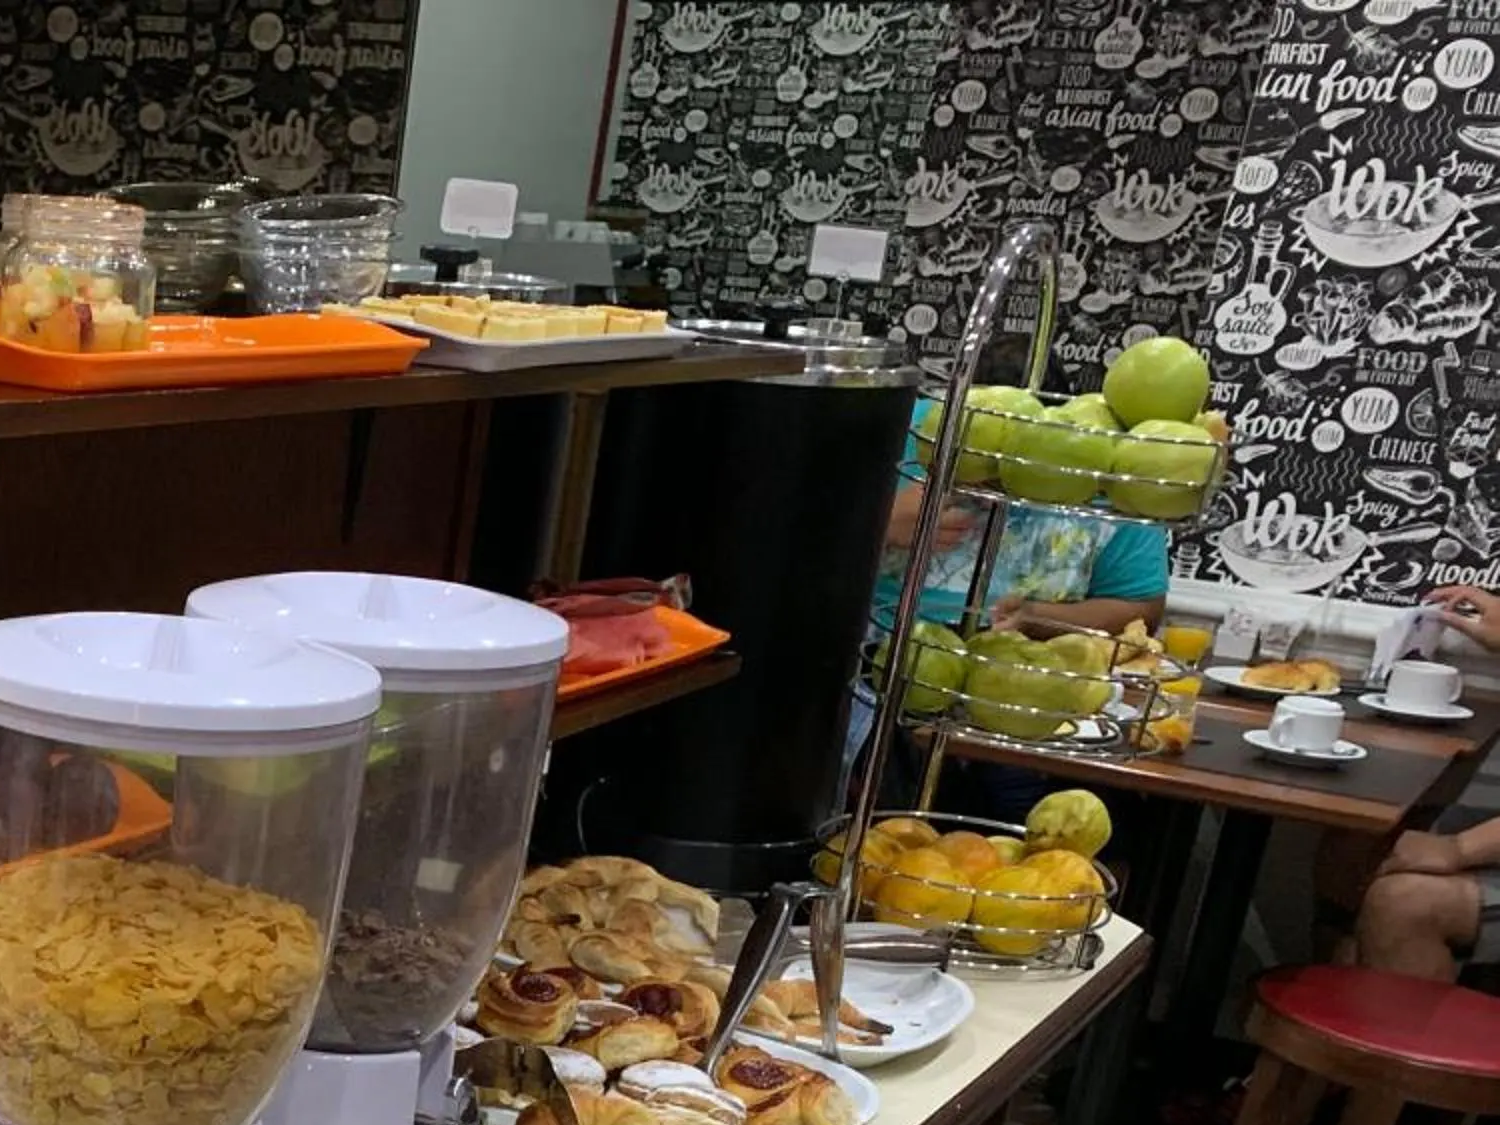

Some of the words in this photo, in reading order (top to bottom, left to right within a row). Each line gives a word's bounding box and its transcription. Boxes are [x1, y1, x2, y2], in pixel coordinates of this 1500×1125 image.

[1444, 47, 1488, 78] YUM
[1315, 57, 1407, 113] food
[1045, 105, 1102, 131] asian
[1104, 99, 1164, 138] food
[1437, 150, 1496, 189] Spicy
[1113, 167, 1187, 213] Wok
[1330, 156, 1444, 225] Wok
[1219, 315, 1275, 337] sauce
[1233, 294, 1276, 321] Soy
[1354, 347, 1429, 373] FOOD
[1231, 397, 1317, 448] food
[1351, 395, 1394, 425] YUM
[1369, 433, 1439, 465] CHINESE
[1244, 491, 1351, 557] Wok
[1345, 489, 1400, 527] Spicy
